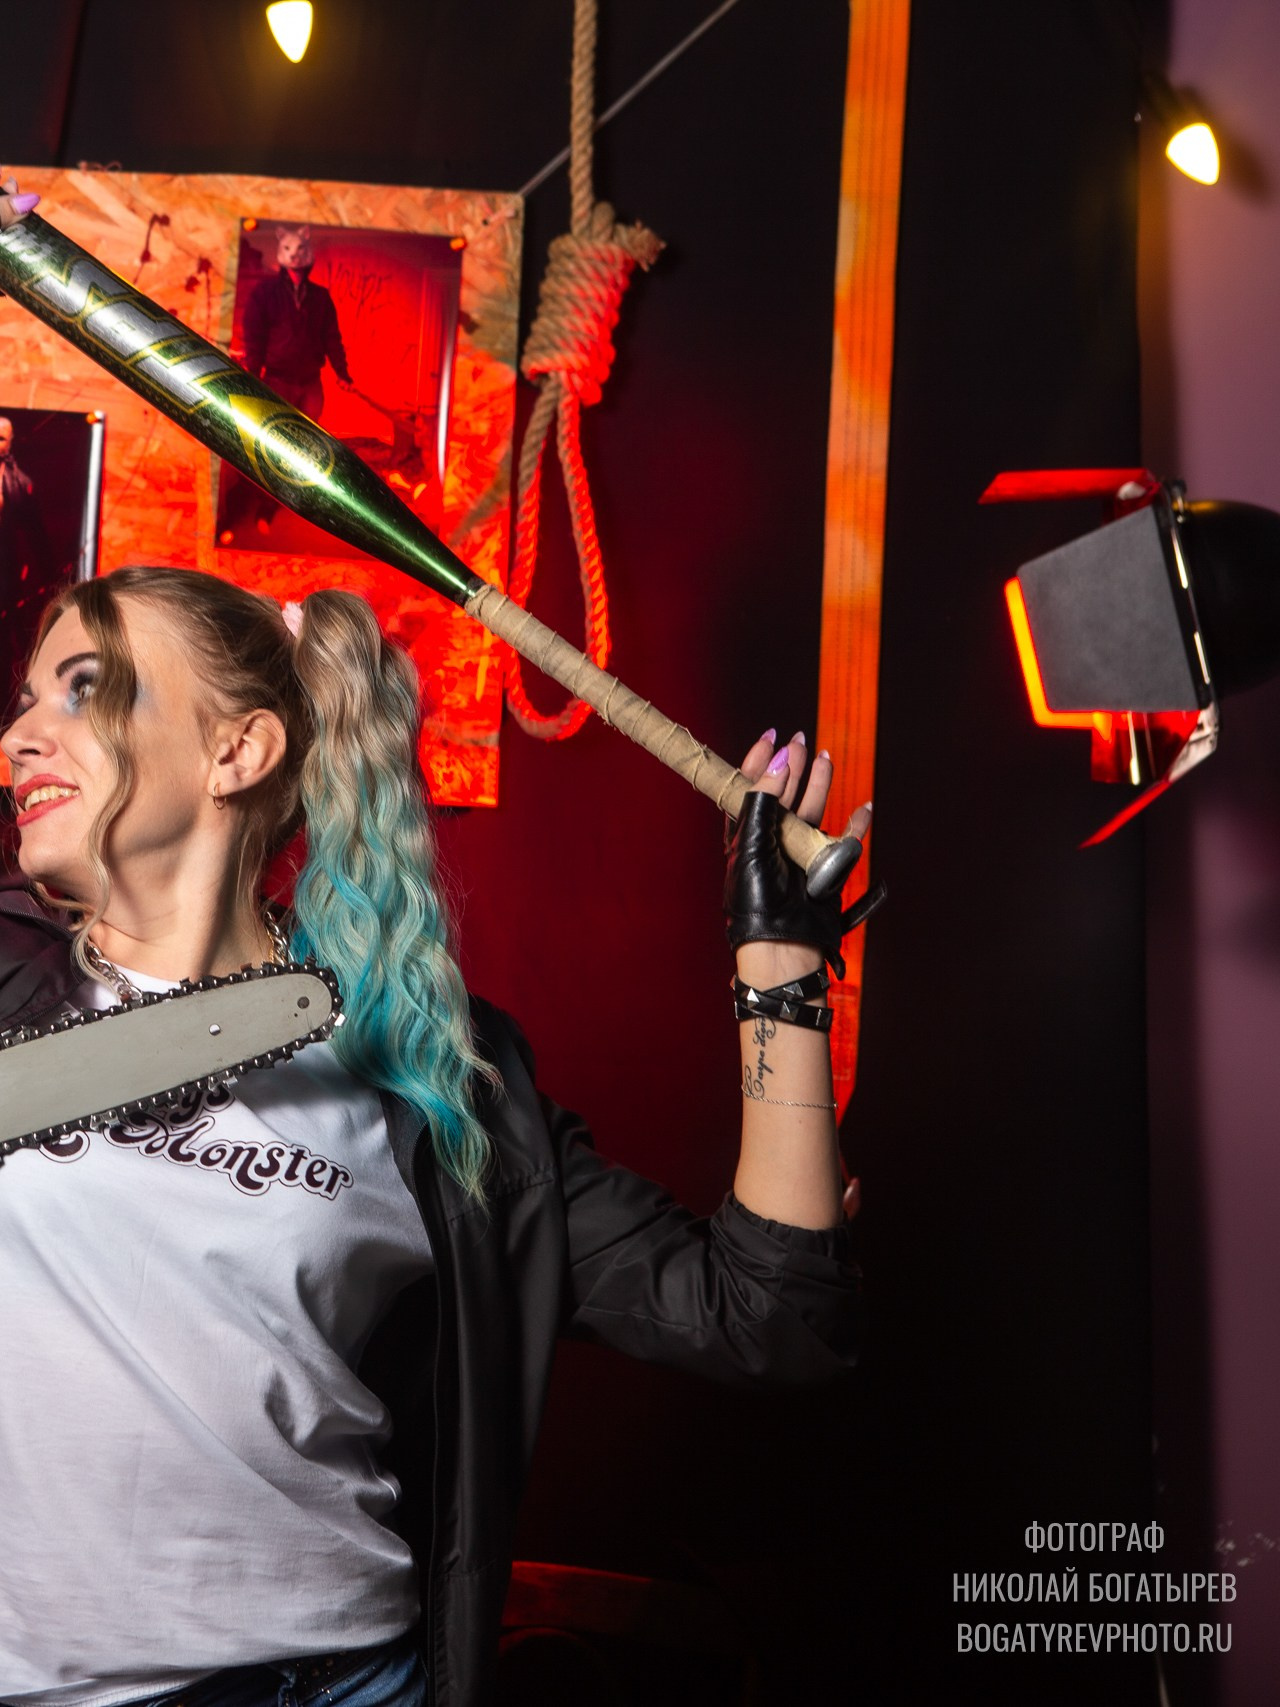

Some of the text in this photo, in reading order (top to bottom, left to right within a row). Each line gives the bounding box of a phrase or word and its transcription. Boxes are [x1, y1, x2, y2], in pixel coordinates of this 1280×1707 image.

[23, 256, 242, 414] TPS
[743, 1050, 773, 1100] Carpe
[140, 1115, 352, 1200] Monster
